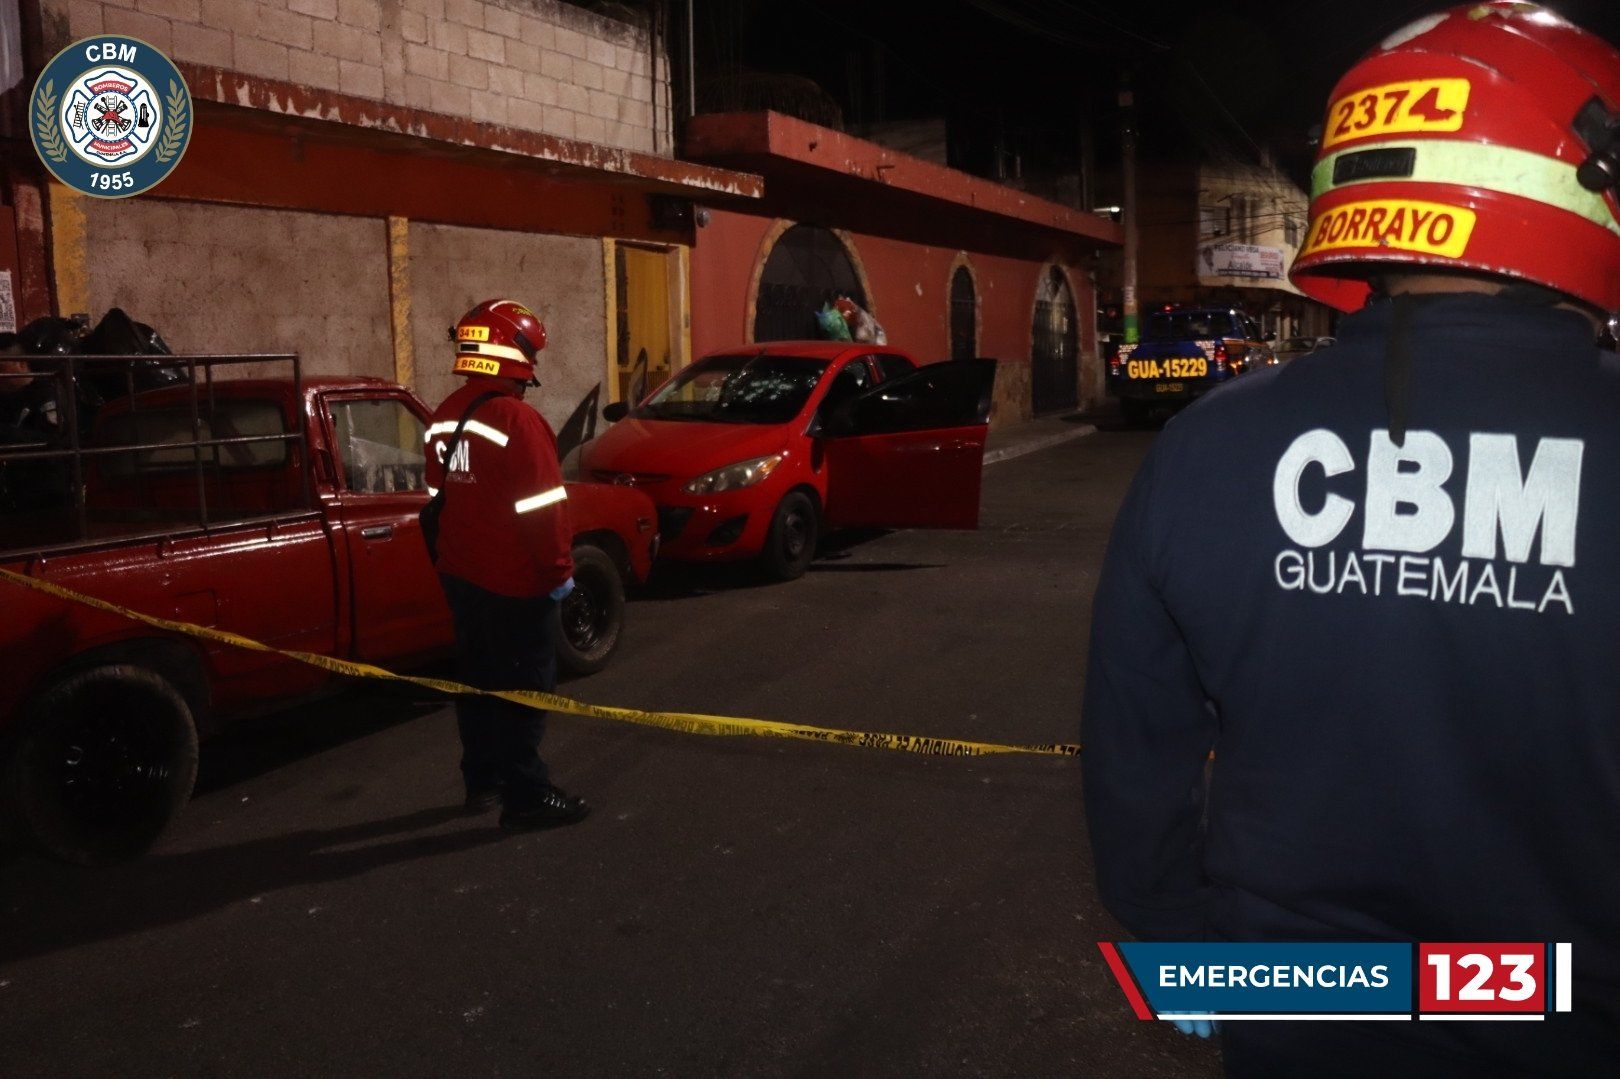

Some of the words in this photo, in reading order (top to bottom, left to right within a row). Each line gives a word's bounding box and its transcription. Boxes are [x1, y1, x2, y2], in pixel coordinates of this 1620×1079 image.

[1311, 207, 1454, 248] BORRAYO
[459, 328, 483, 338] 3411
[1127, 357, 1208, 379] GUA-15229
[1273, 428, 1585, 568] CBM
[1274, 550, 1575, 615] GUATEMALA
